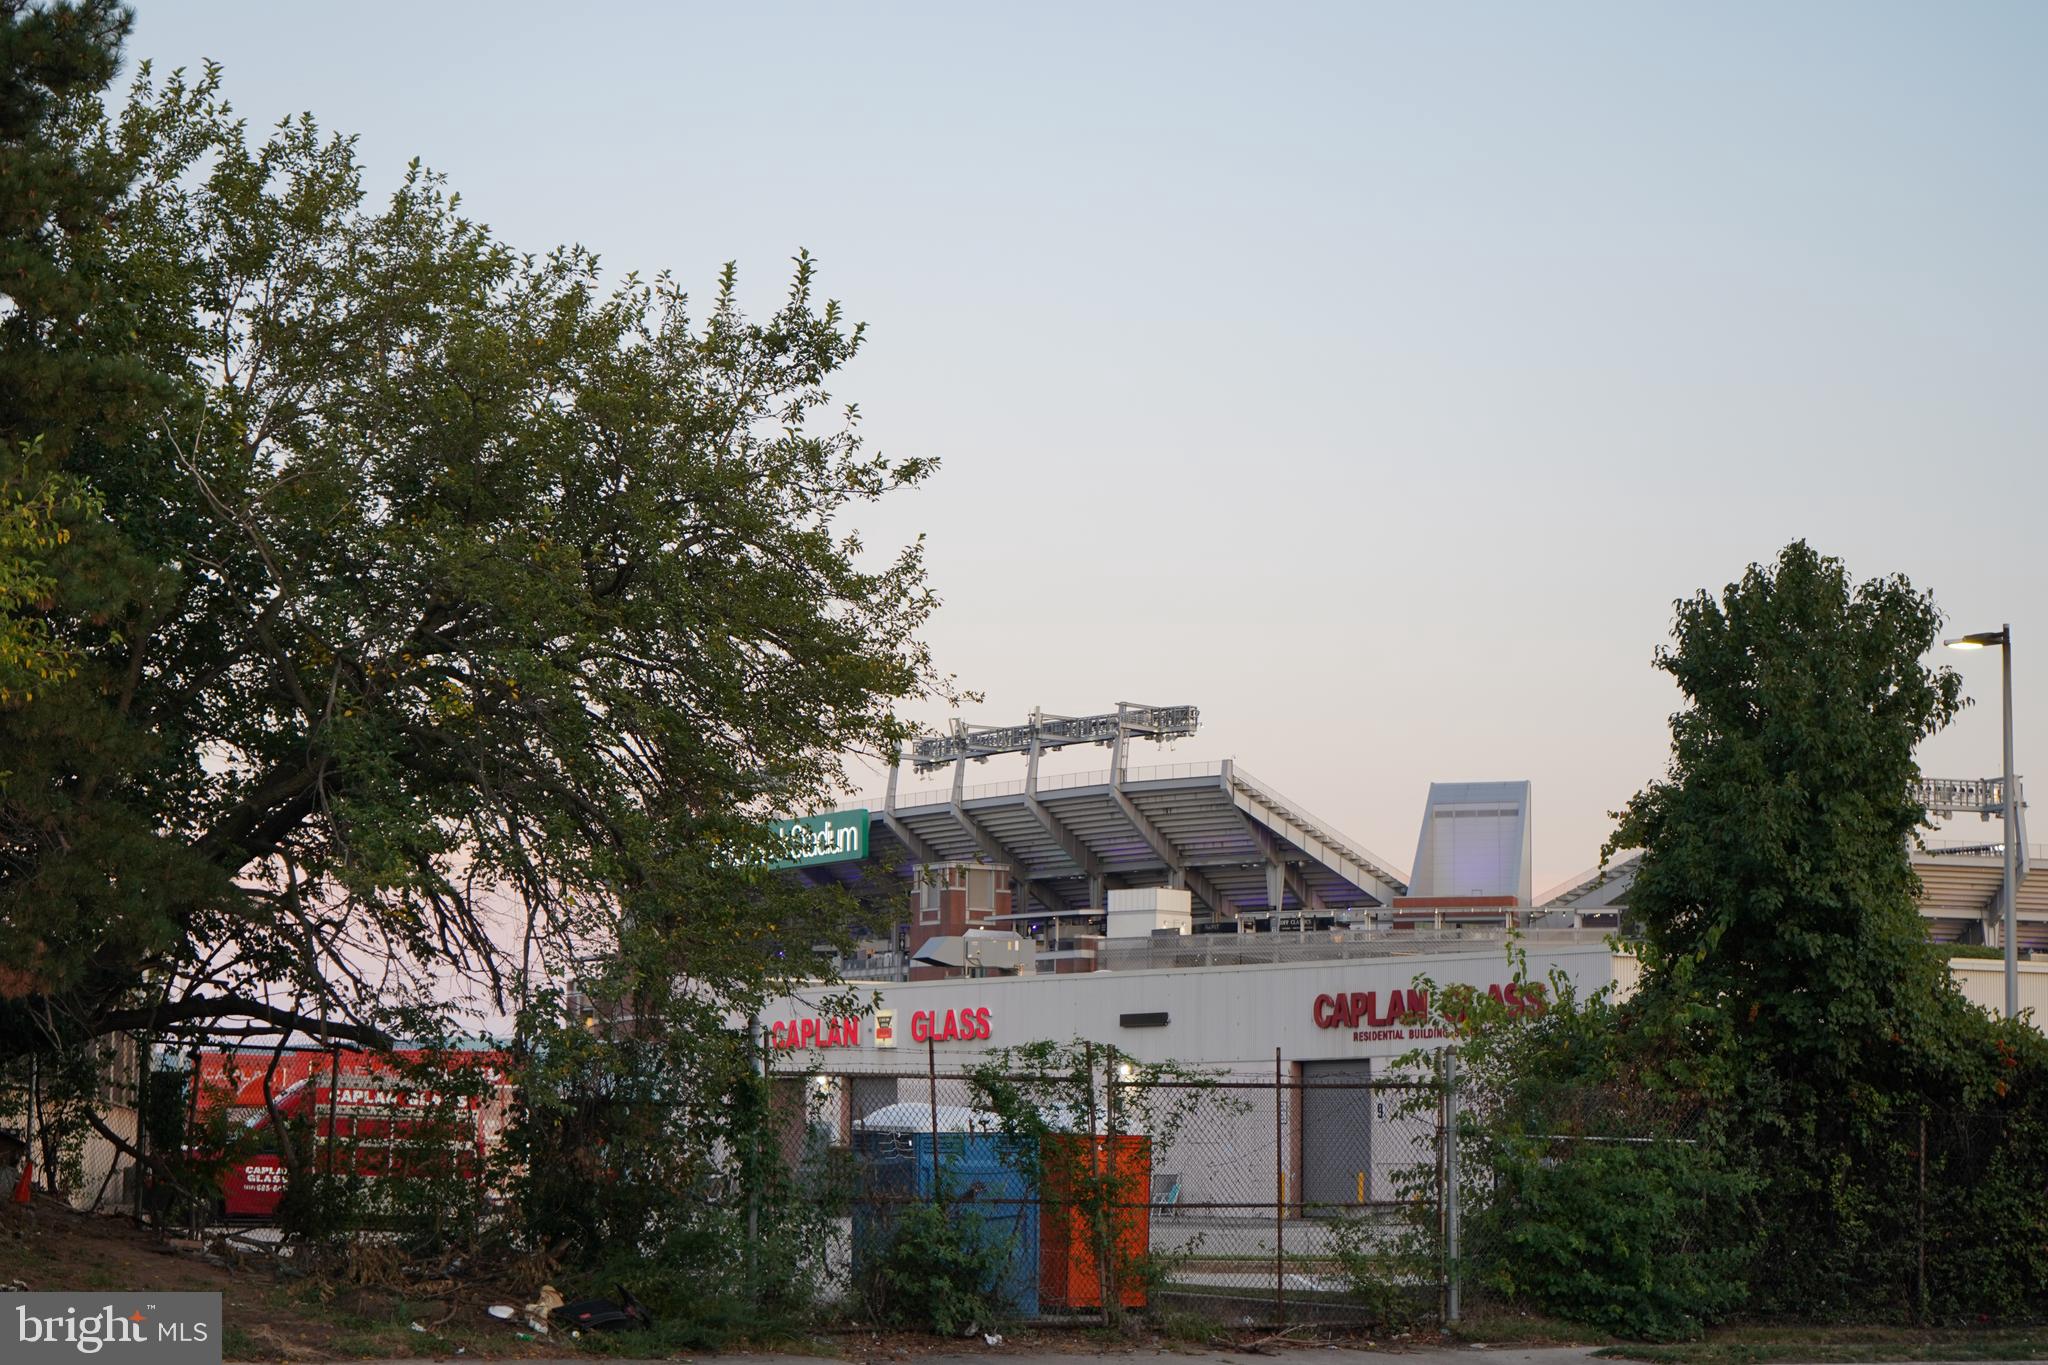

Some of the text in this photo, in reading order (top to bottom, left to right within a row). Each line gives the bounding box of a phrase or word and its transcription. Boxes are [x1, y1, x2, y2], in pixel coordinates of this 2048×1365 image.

[1313, 982, 1547, 1029] CAPLAN ASS
[772, 1016, 859, 1050] CAPLAN
[911, 1007, 991, 1043] GLASS
[1353, 1029, 1404, 1042] RESIDENTIAL
[1409, 1028, 1448, 1040] BUILDING
[329, 1089, 468, 1108] CAPLAN GLAS
[1377, 1103, 1384, 1119] 9
